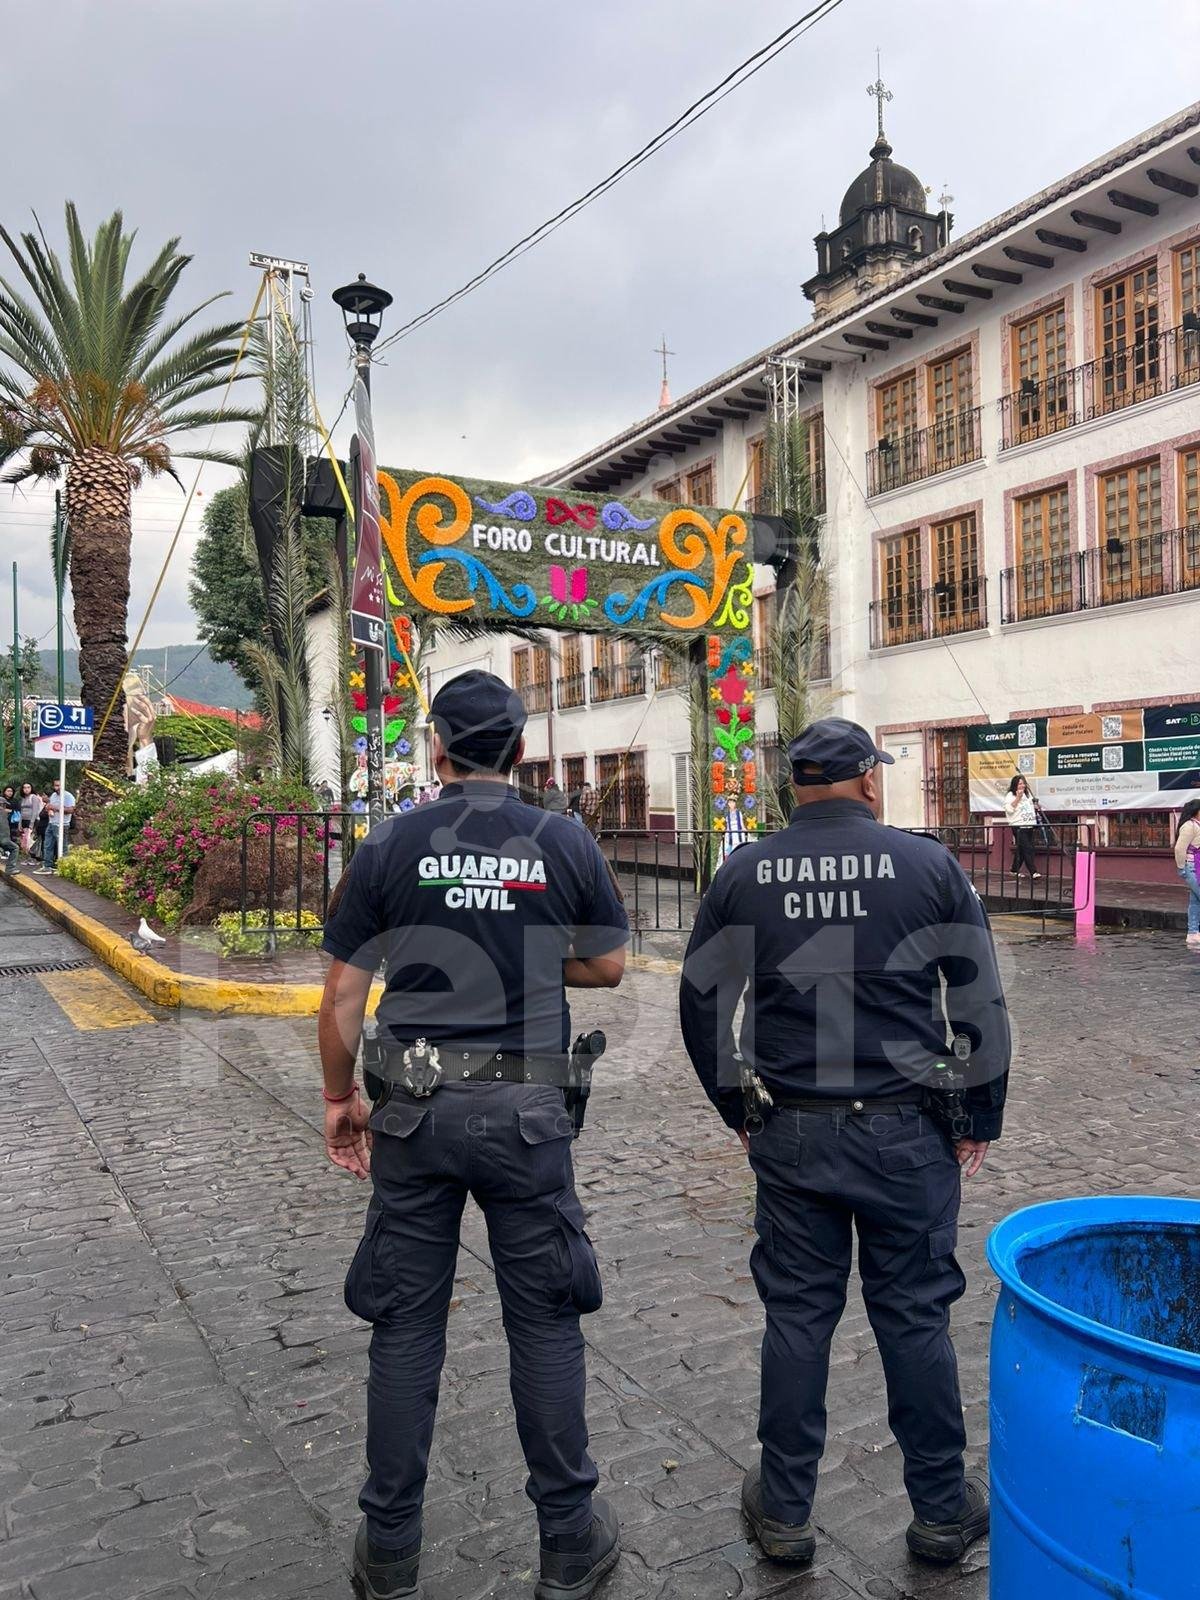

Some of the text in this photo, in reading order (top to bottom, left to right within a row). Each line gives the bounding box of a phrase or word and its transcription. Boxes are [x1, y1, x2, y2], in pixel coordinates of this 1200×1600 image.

[472, 524, 660, 567] FORO CULTURAL
[45, 709, 57, 724] E
[65, 741, 91, 753] plaza
[858, 754, 876, 773] SSP
[418, 855, 547, 884] GUARDIA
[756, 854, 896, 884] GUARDIA
[445, 887, 516, 911] CIVIL
[784, 890, 868, 919] CIVIL
